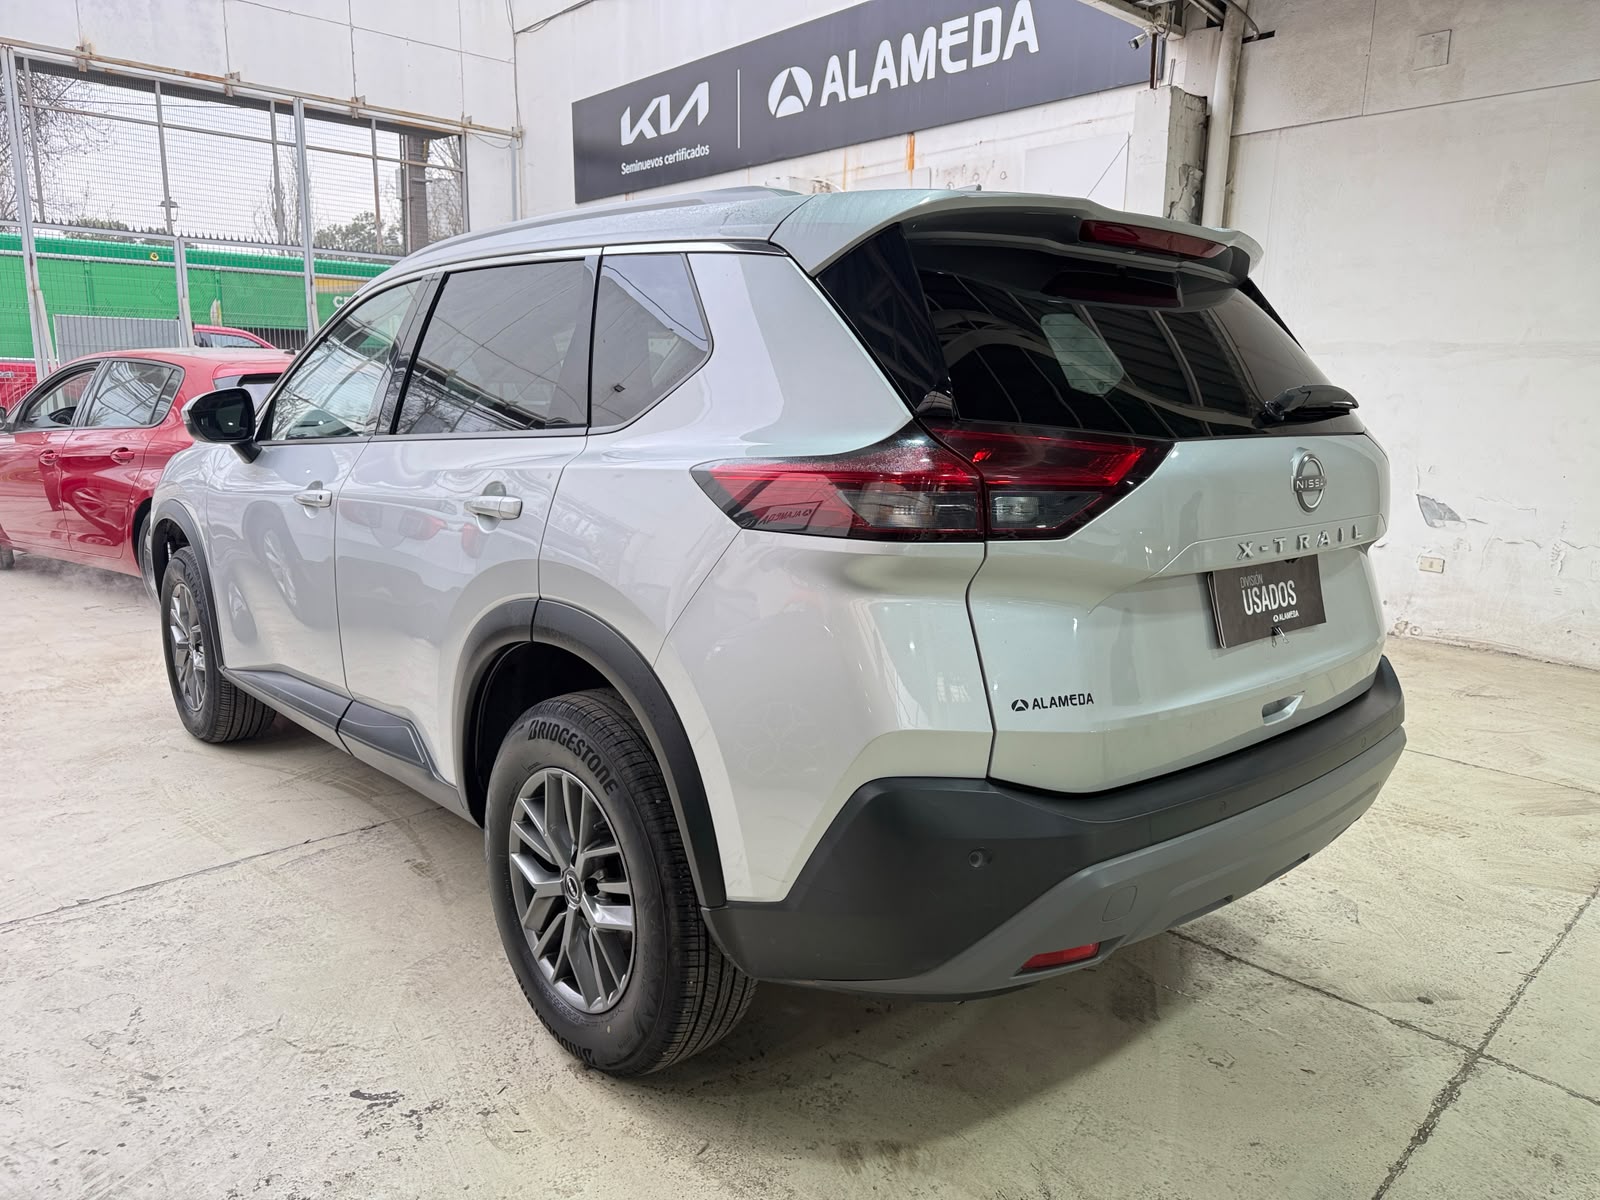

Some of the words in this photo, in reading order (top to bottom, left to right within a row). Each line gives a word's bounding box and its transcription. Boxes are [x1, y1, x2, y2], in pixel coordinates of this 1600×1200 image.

[820, 0, 1039, 107] ALAMEDA
[621, 81, 709, 146] KIA
[621, 157, 663, 175] Seminuevos
[664, 144, 710, 165] certificados
[1296, 478, 1325, 489] NISS
[1237, 525, 1363, 560] X-TRAIL
[1240, 571, 1263, 588] DIVISIÓN
[1242, 580, 1297, 615] USADOS
[1278, 609, 1300, 621] ALAMEDA
[1032, 692, 1094, 710] ALAMEDA
[528, 719, 619, 796] BRIDGESTONE
